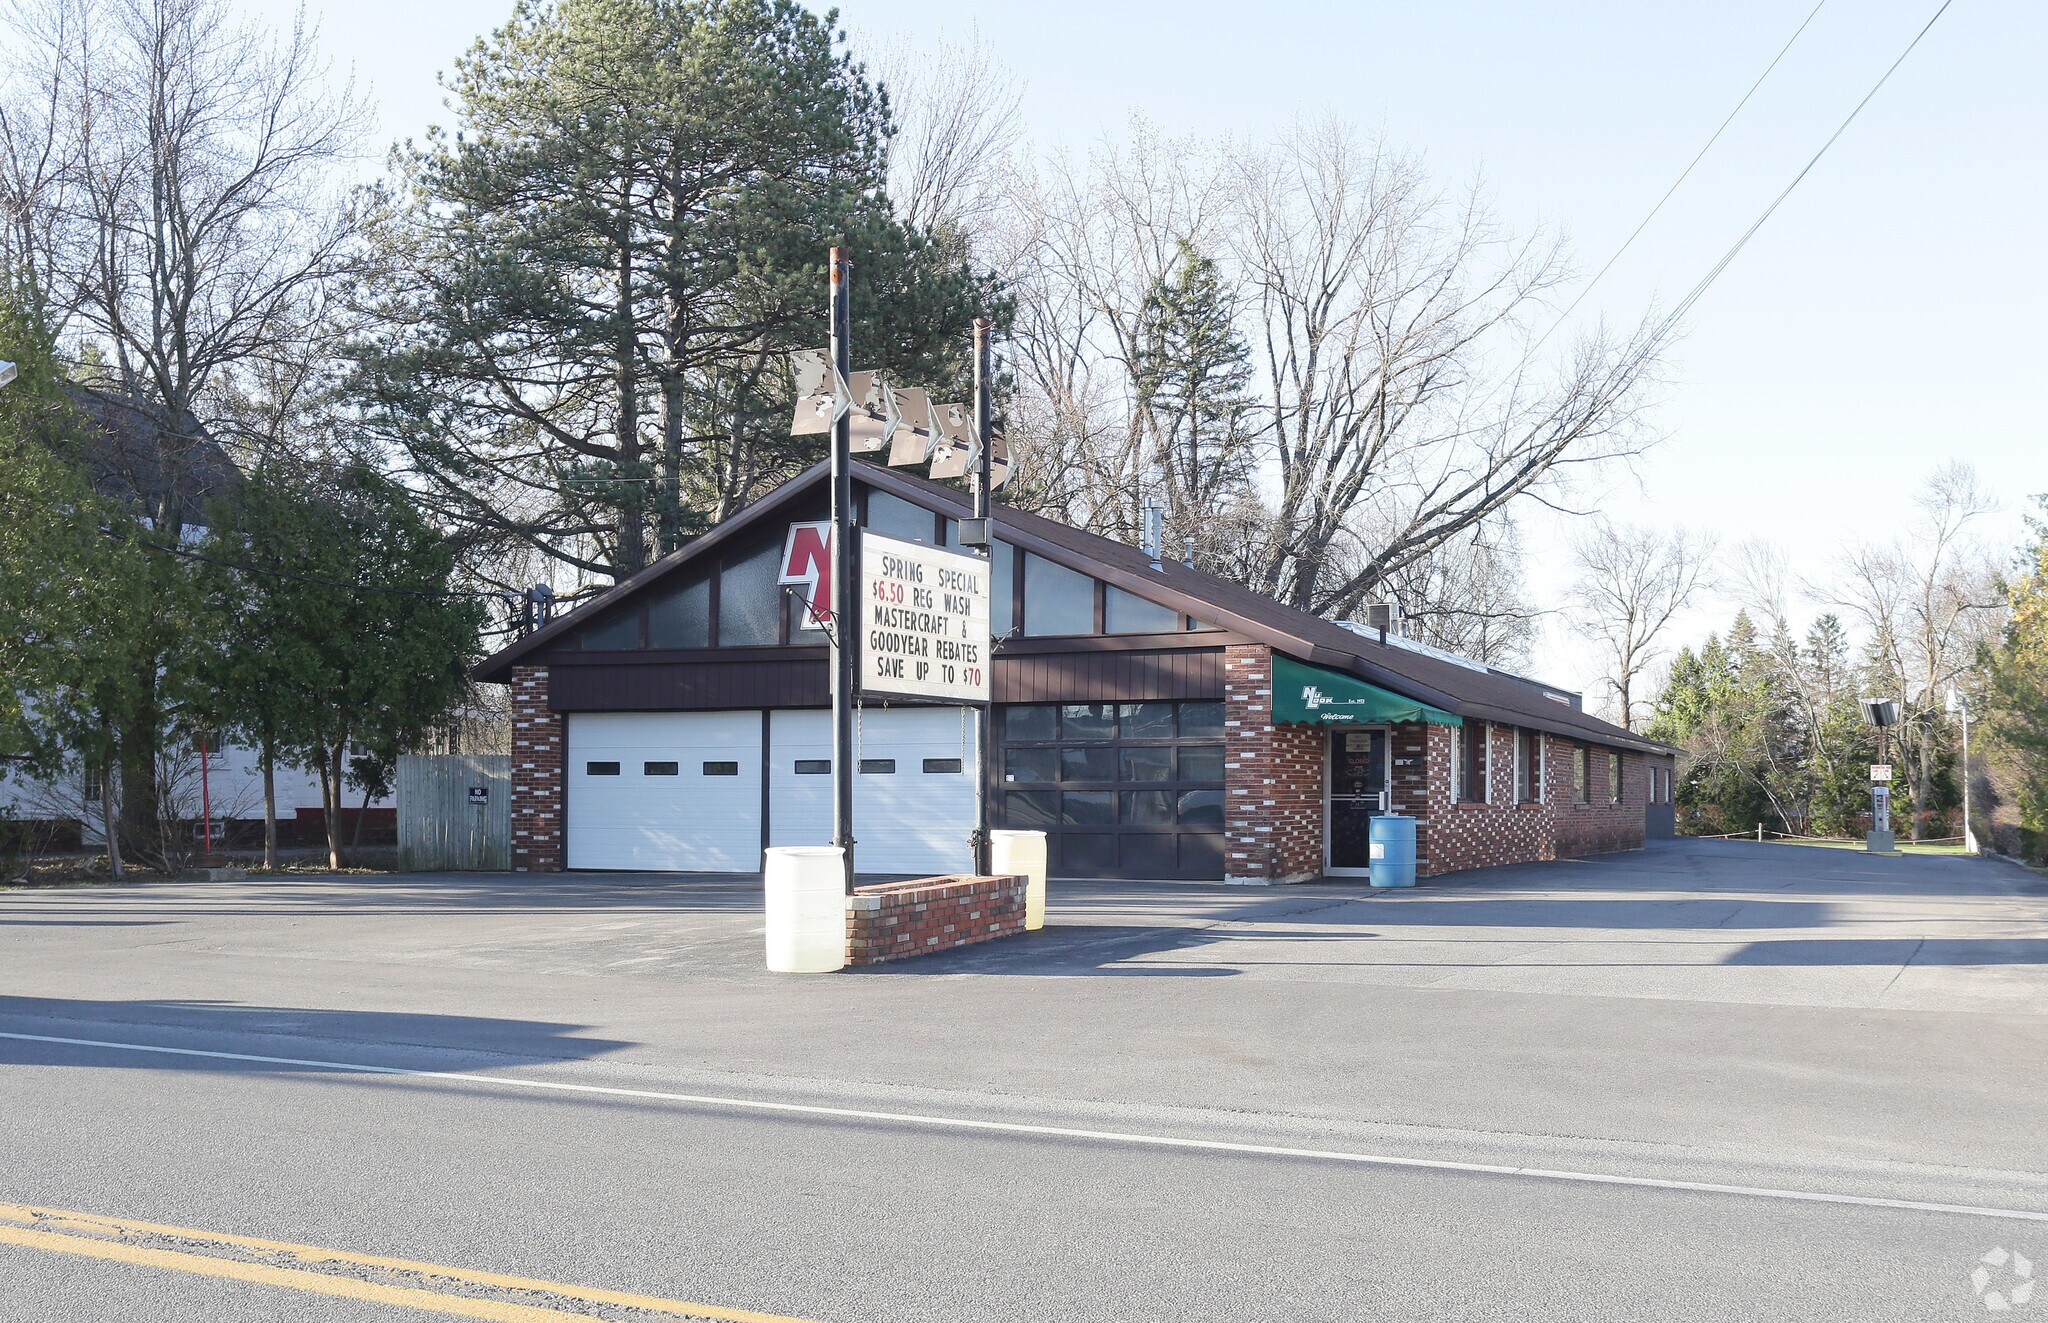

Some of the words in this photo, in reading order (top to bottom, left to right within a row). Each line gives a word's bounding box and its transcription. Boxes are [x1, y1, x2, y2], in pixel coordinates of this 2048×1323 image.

[882, 556, 923, 583] SPRING
[938, 568, 979, 595] SPECIAL
[872, 579, 904, 604] $6.50
[913, 587, 933, 609] REG
[944, 593, 971, 616] WASH
[874, 605, 949, 636] MASTERCRAFT
[961, 620, 967, 638] &
[870, 630, 928, 657] GOODYEAR
[936, 640, 978, 664] REBATES
[877, 656, 904, 679] SAVE
[916, 661, 929, 681] UP
[941, 664, 955, 684] TO
[963, 667, 981, 687] $70
[1320, 712, 1354, 720] Welcome
